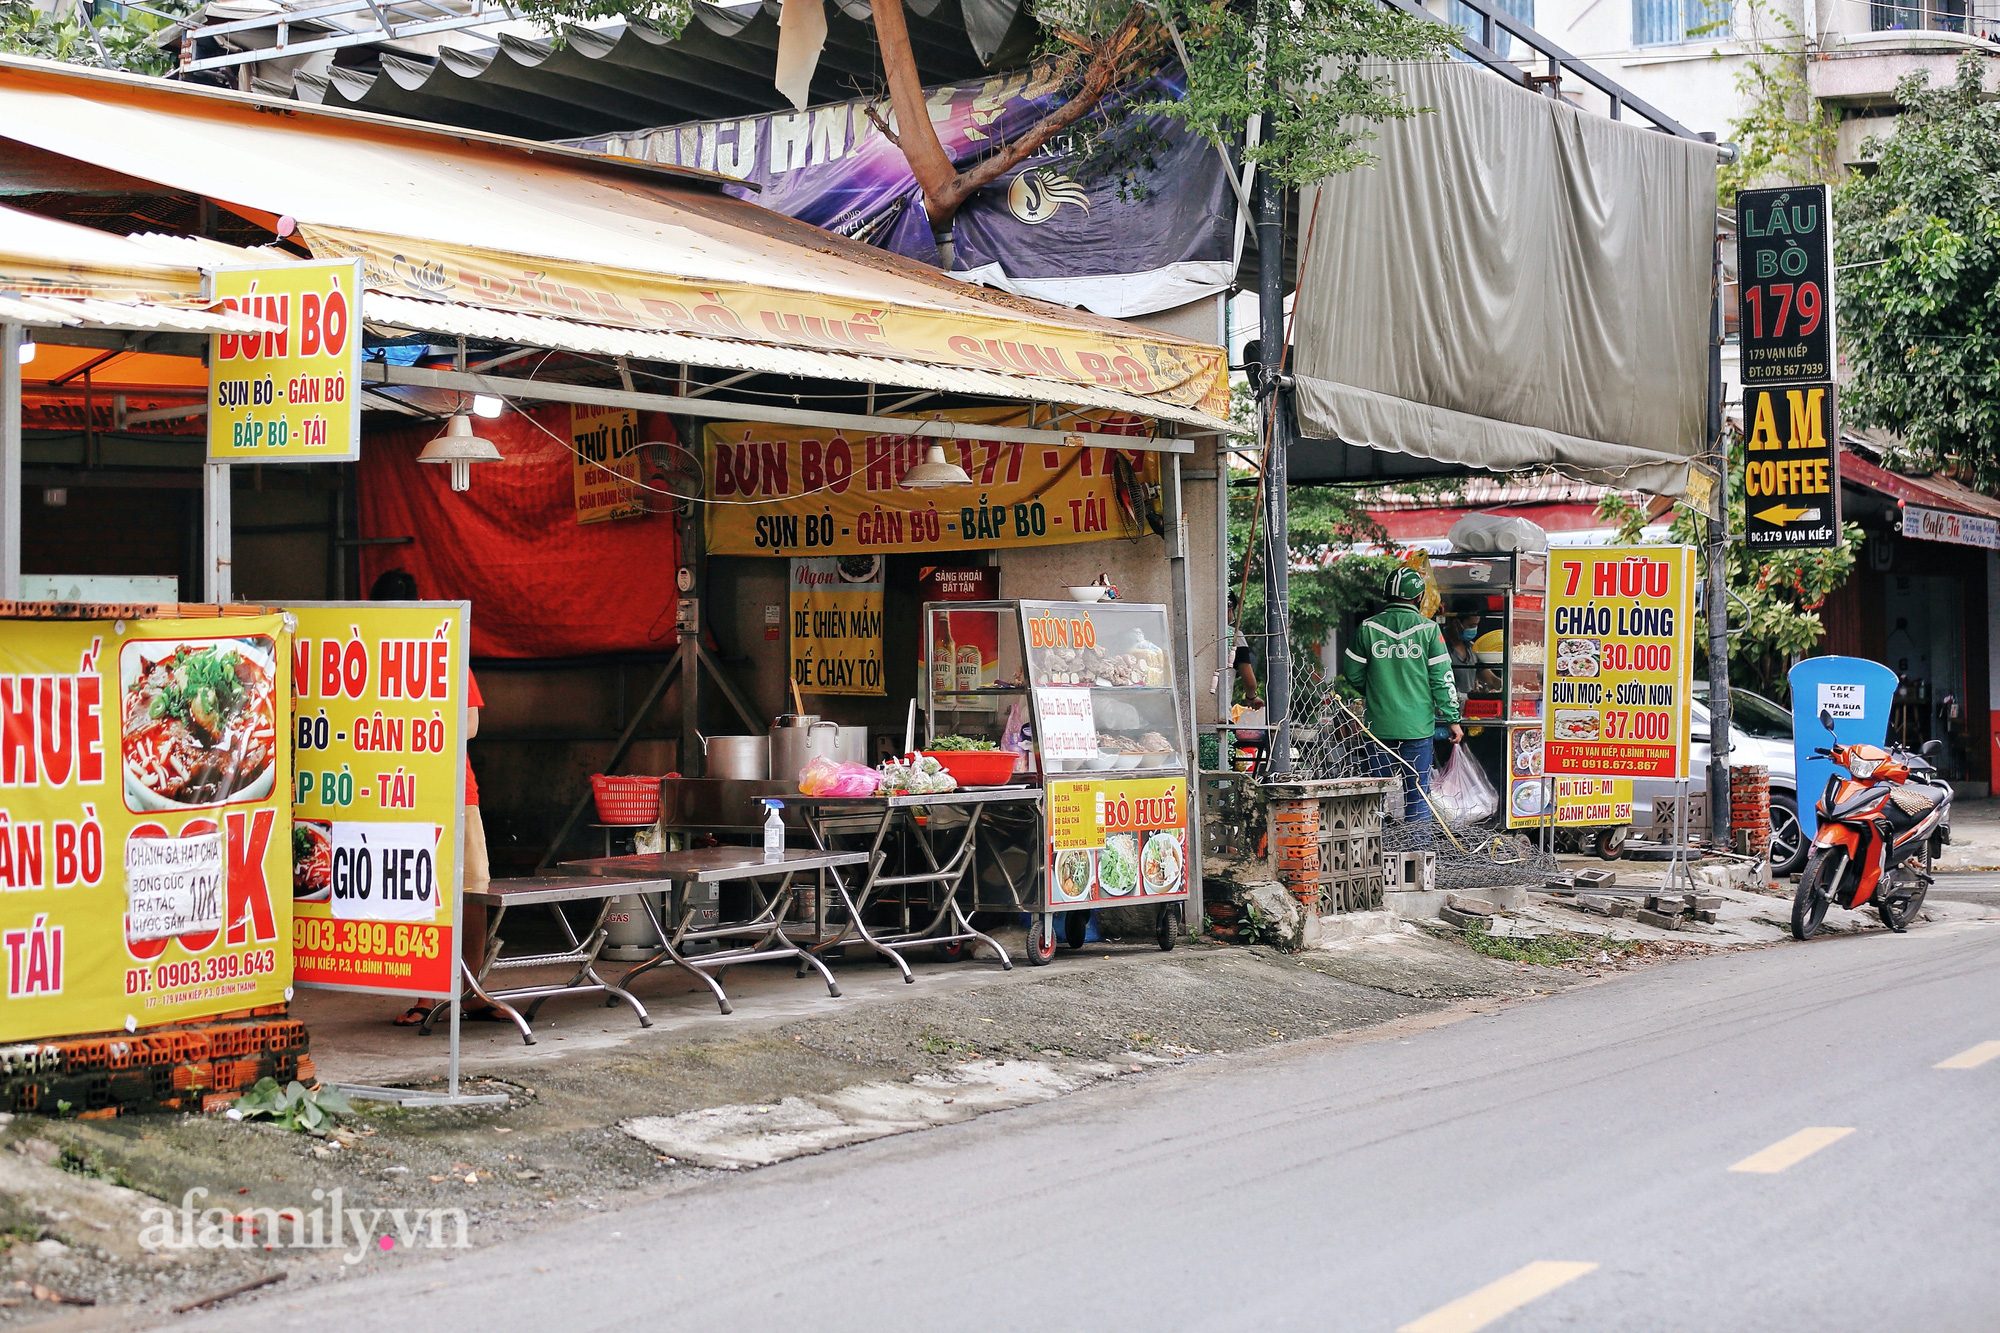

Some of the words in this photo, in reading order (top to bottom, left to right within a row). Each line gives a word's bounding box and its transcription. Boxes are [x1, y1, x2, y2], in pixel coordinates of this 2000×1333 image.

[1746, 194, 1816, 237] LẨU
[1757, 240, 1808, 278] BÒ
[301, 277, 347, 356] BÒ
[1746, 281, 1822, 338] 179
[1076, 345, 1157, 393] BÒ
[1749, 349, 1764, 361] 179
[1767, 348, 1785, 362] VẠN
[1788, 343, 1808, 359] KIẾP
[1749, 366, 1764, 378] ĐT:
[1765, 365, 1782, 377] 078
[1783, 364, 1800, 376] 567
[1801, 363, 1823, 375] 7939
[218, 380, 249, 411] SỤN
[253, 373, 273, 405] BÒ
[289, 373, 320, 404] GÂN
[325, 371, 345, 403] BÒ
[234, 412, 263, 447] BẮP
[268, 415, 288, 446] BÒ
[303, 415, 327, 445] TÁI
[575, 424, 608, 466] THỨ
[612, 413, 639, 459] LỖI
[715, 430, 789, 497] BÚN
[801, 429, 853, 494] BÒ
[1745, 458, 1830, 497] COFFEE
[755, 515, 798, 554] SỤN
[806, 506, 834, 547] BÒ
[857, 504, 904, 545] GÂN
[910, 501, 940, 543] BÒ
[961, 493, 1007, 540] BẮP
[1014, 494, 1046, 537] BÒ
[1069, 491, 1108, 533] TÁI
[1785, 530, 1806, 544] VẠN
[1809, 525, 1833, 541] KIẾP
[1922, 511, 1945, 539] Café
[795, 565, 834, 588] Ngon
[1563, 562, 1583, 596] 7
[1593, 556, 1669, 597] HỮU
[795, 598, 810, 638] DẾ
[813, 603, 846, 638] CHIÊN
[850, 598, 881, 638] MẮM
[1030, 610, 1068, 648] BÚN
[1071, 611, 1096, 649] BÒ
[1555, 601, 1611, 636] CHÁO
[1618, 601, 1673, 637] LÒNG
[322, 627, 367, 698] BÒ
[380, 622, 449, 699] HUẾ
[795, 646, 813, 685] DẾ
[817, 650, 855, 686] CHÁY
[858, 649, 881, 687] TỎI
[1371, 639, 1423, 659] Grab
[1602, 644, 1671, 672] 30.000
[1, 638, 103, 786] HUẾ
[1552, 679, 1574, 704] BÚN
[1578, 684, 1602, 709] MỌC
[1617, 679, 1646, 705] SƯỜN
[1649, 685, 1673, 706] NON
[299, 709, 329, 750] BÒ
[354, 711, 404, 752] GÂN
[412, 711, 444, 754] BÒ
[1605, 711, 1670, 741] 37.000
[1552, 745, 1564, 755] 177
[1571, 746, 1583, 756] 179
[1585, 747, 1600, 758] VẠN
[1601, 745, 1619, 758] KIẾP,
[1620, 746, 1645, 759] Q.BÌNH
[1646, 748, 1670, 761] THẠNH
[1562, 759, 1579, 769] ĐT:
[1582, 759, 1658, 771] 0918.673.867
[322, 765, 353, 806] BÒ
[378, 768, 415, 808] TÁI
[1105, 793, 1129, 827] BÒ
[1135, 785, 1177, 825] HUẾ
[1586, 804, 1610, 820] CANH
[1614, 804, 1631, 818] 35K
[56, 807, 100, 884] BÒ
[333, 833, 372, 900] GIÒ
[382, 848, 432, 901] HEO
[190, 874, 219, 921] 10K
[6, 917, 62, 995] TÁI
[126, 969, 151, 994] ĐT:
[157, 950, 274, 989] 0903.399.643
[300, 956, 316, 970] VẠN
[355, 958, 382, 975] Q.BÌNH
[385, 962, 412, 978] THẠNH
[146, 997, 156, 1008] 177
[163, 994, 173, 1004] 179
[175, 991, 187, 1005] VẠN
[237, 981, 256, 993] THẠNH
